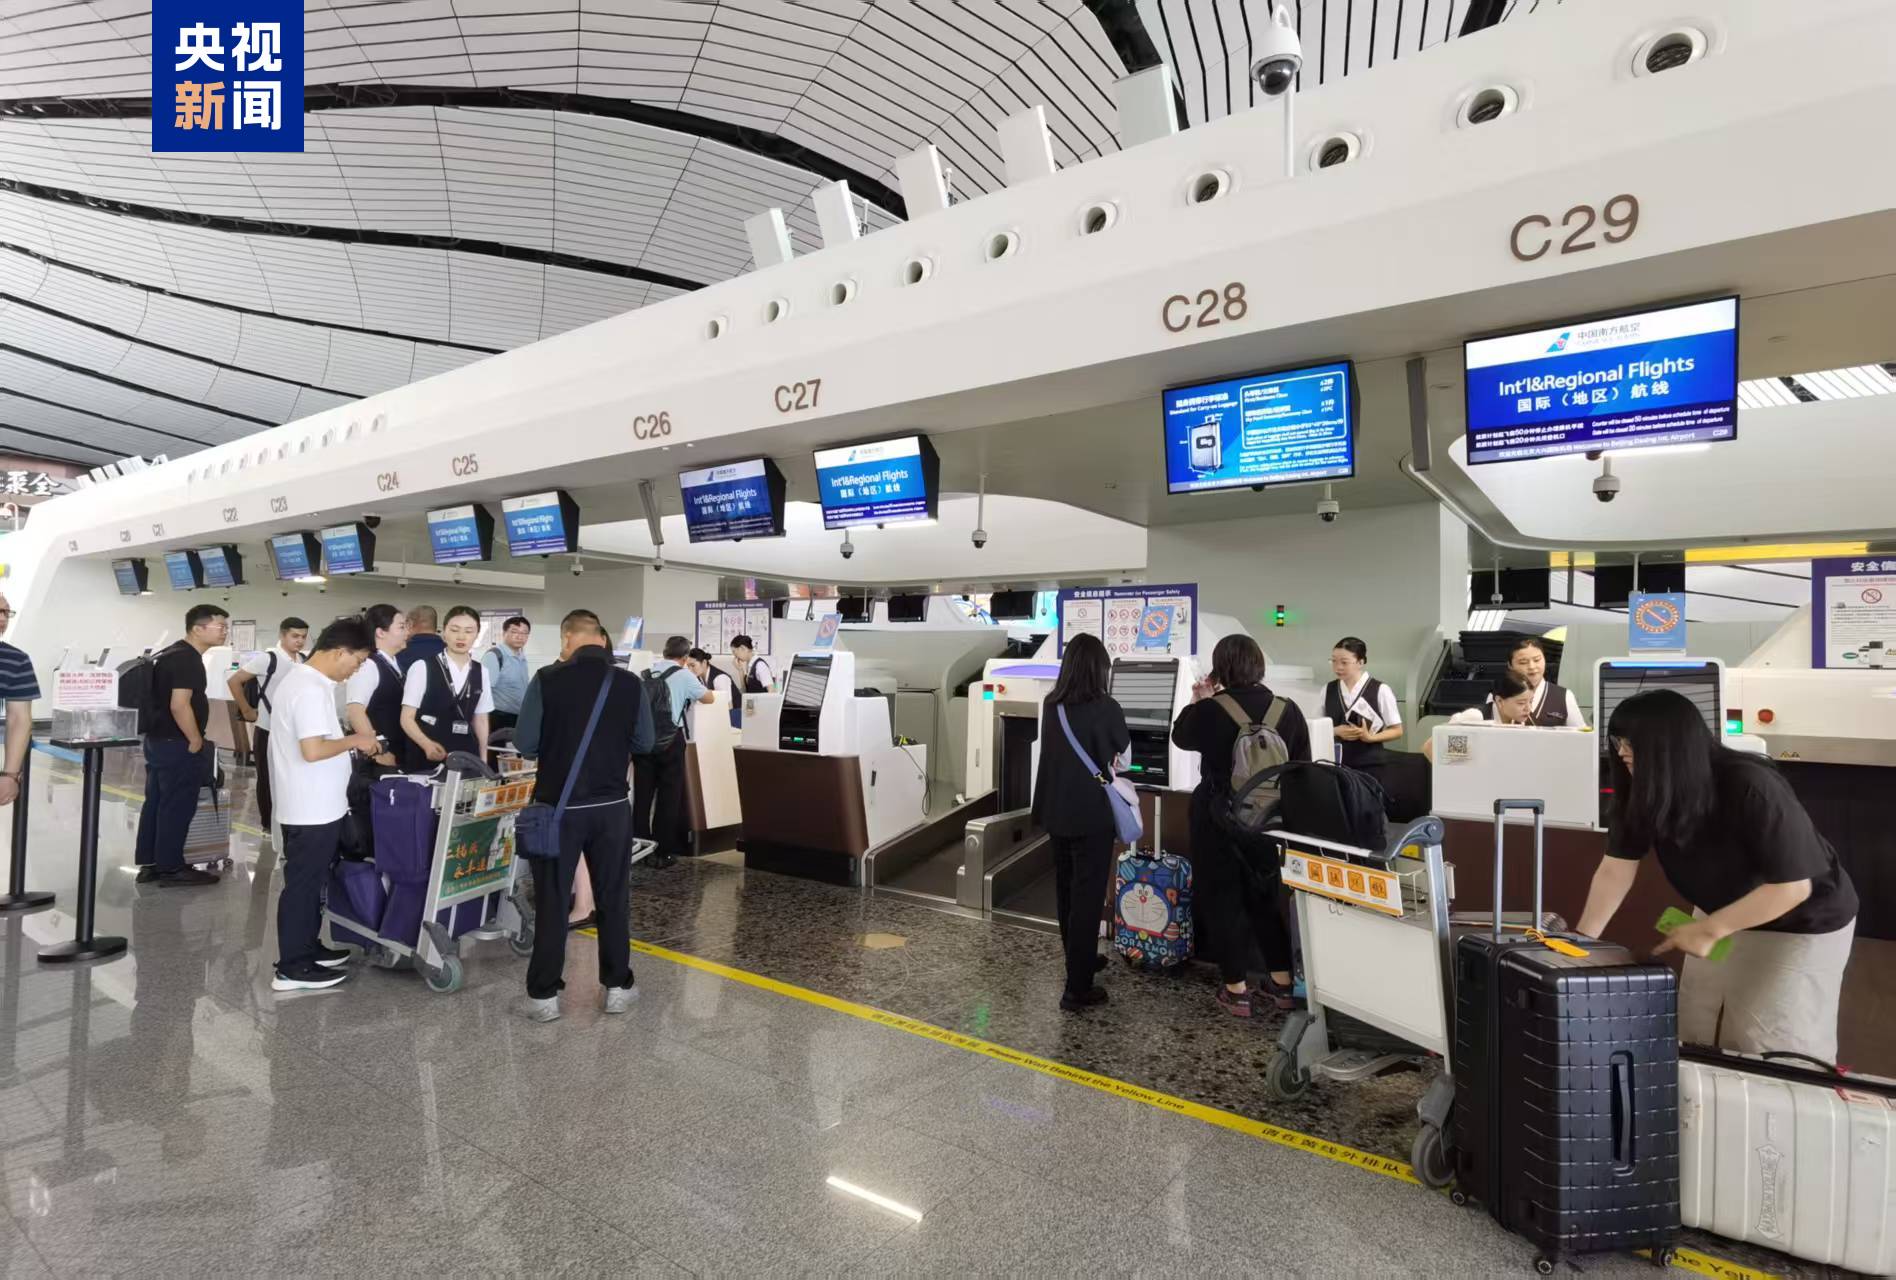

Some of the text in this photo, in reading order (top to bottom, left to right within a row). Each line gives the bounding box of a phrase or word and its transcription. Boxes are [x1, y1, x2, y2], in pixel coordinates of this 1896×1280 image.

[1510, 193, 1639, 262] C29
[1162, 282, 1248, 333] C28
[1628, 356, 1695, 379] Flights
[774, 378, 822, 413] C27
[633, 411, 672, 440] C26
[451, 453, 478, 476] C25
[882, 469, 908, 482] Flights
[377, 471, 400, 492] C24
[270, 496, 288, 513] C23
[736, 487, 757, 500] Flights
[1022, 1057, 1050, 1072] Wait
[1050, 1066, 1091, 1083] Behind
[1092, 1077, 1111, 1090] the
[1112, 1083, 1154, 1101] Yellow
[1156, 1095, 1185, 1111] Line
[1672, 1252, 1701, 1267] he
